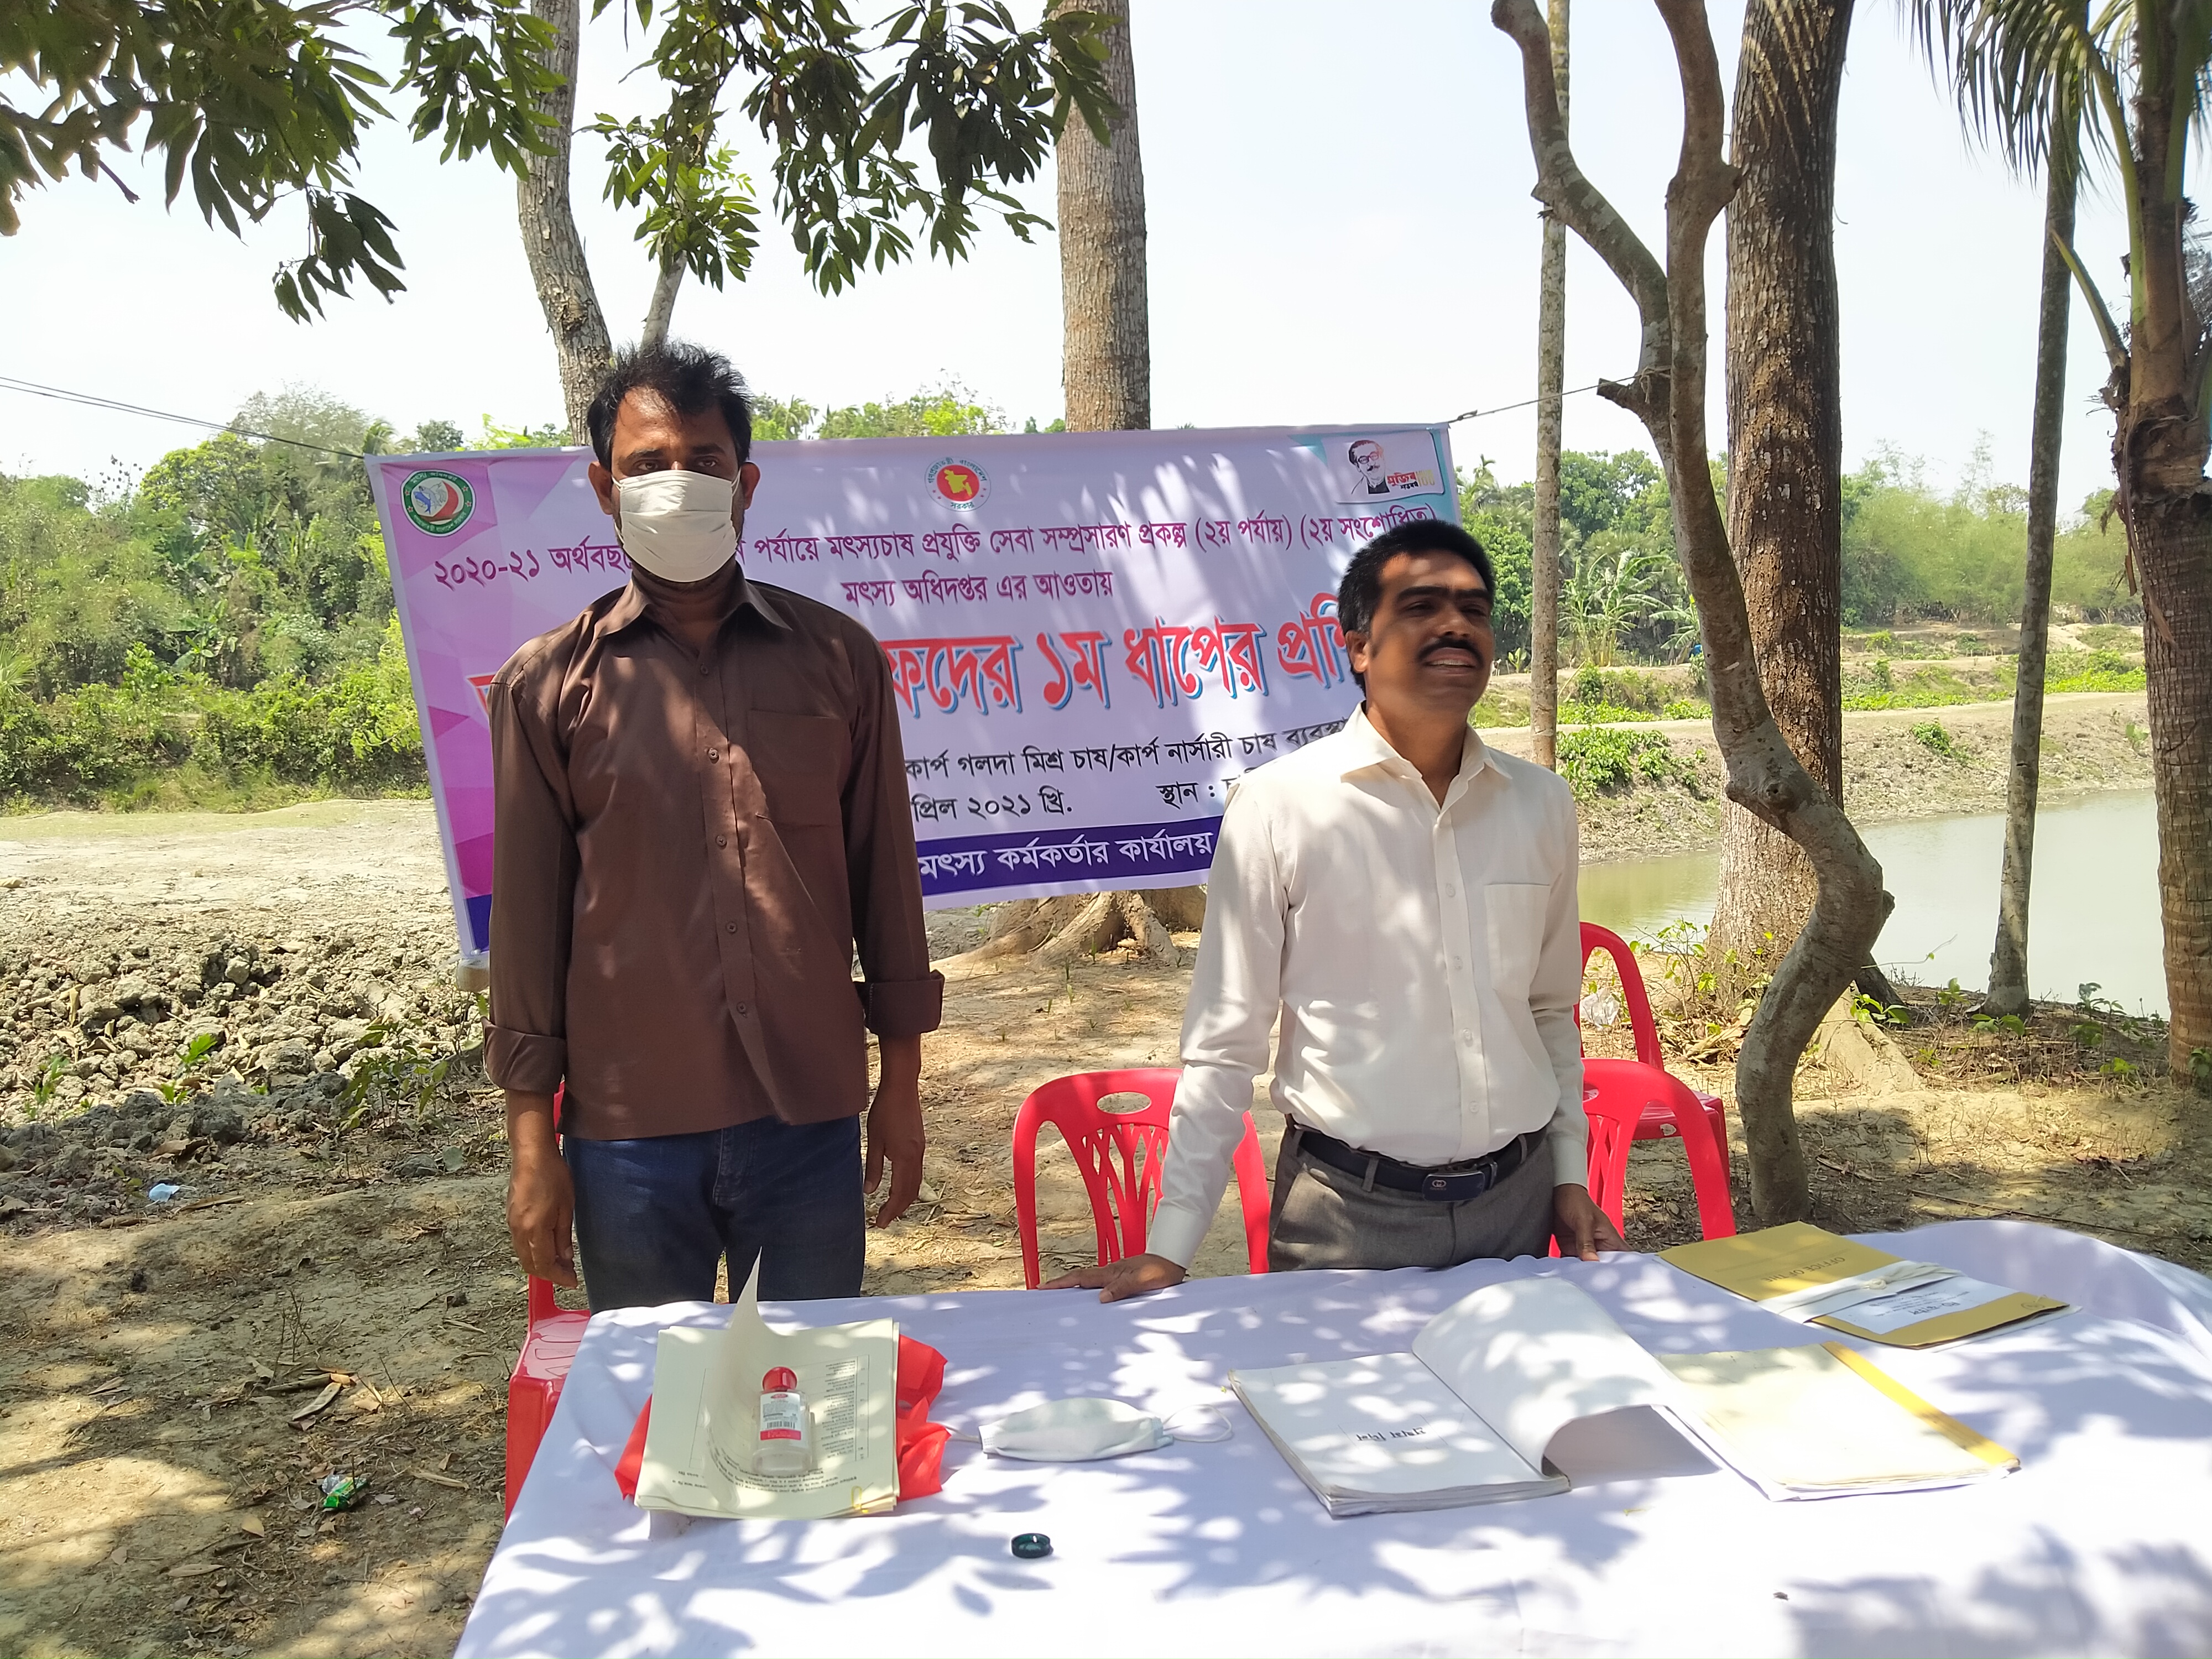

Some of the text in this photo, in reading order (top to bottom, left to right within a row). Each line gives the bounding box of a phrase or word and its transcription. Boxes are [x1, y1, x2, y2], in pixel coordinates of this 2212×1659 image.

[434, 549, 540, 591] ২০২০-২১
[754, 528, 820, 564] পর্যায়ে
[824, 531, 915, 561] মৎস্যচাষ
[922, 523, 980, 562] প্রযুক্তি
[990, 525, 1034, 554] সেবা
[1039, 520, 1132, 555] সম্প্রসারণ
[1139, 520, 1187, 549] প্রকল্প
[1195, 517, 1232, 553] (২য়
[1238, 509, 1292, 551] পর্যায়)
[1301, 514, 1334, 550] (২য়
[841, 569, 1114, 608] মৎস্য অধিদপ্তর এর আওতায়
[878, 634, 1024, 719] ফদের
[1036, 631, 1112, 711] ১ম
[1123, 615, 1267, 709] ধাপের
[957, 750, 1016, 777] গলদা
[1020, 745, 1064, 773] মিশ্র
[1069, 736, 1160, 772] চাষ/কার্প
[1164, 732, 1233, 764] নার্সারী
[1237, 732, 1278, 754] চাষ
[910, 793, 958, 823] প্রিল
[967, 794, 1031, 821] ২০২১
[1155, 780, 1199, 810] স্থান
[917, 828, 1215, 880] মৎস্য কর্মকর্তার কার্যালয়
[1788, 1269, 1805, 1277] OF
[1803, 1256, 1845, 1272] OFFICE
